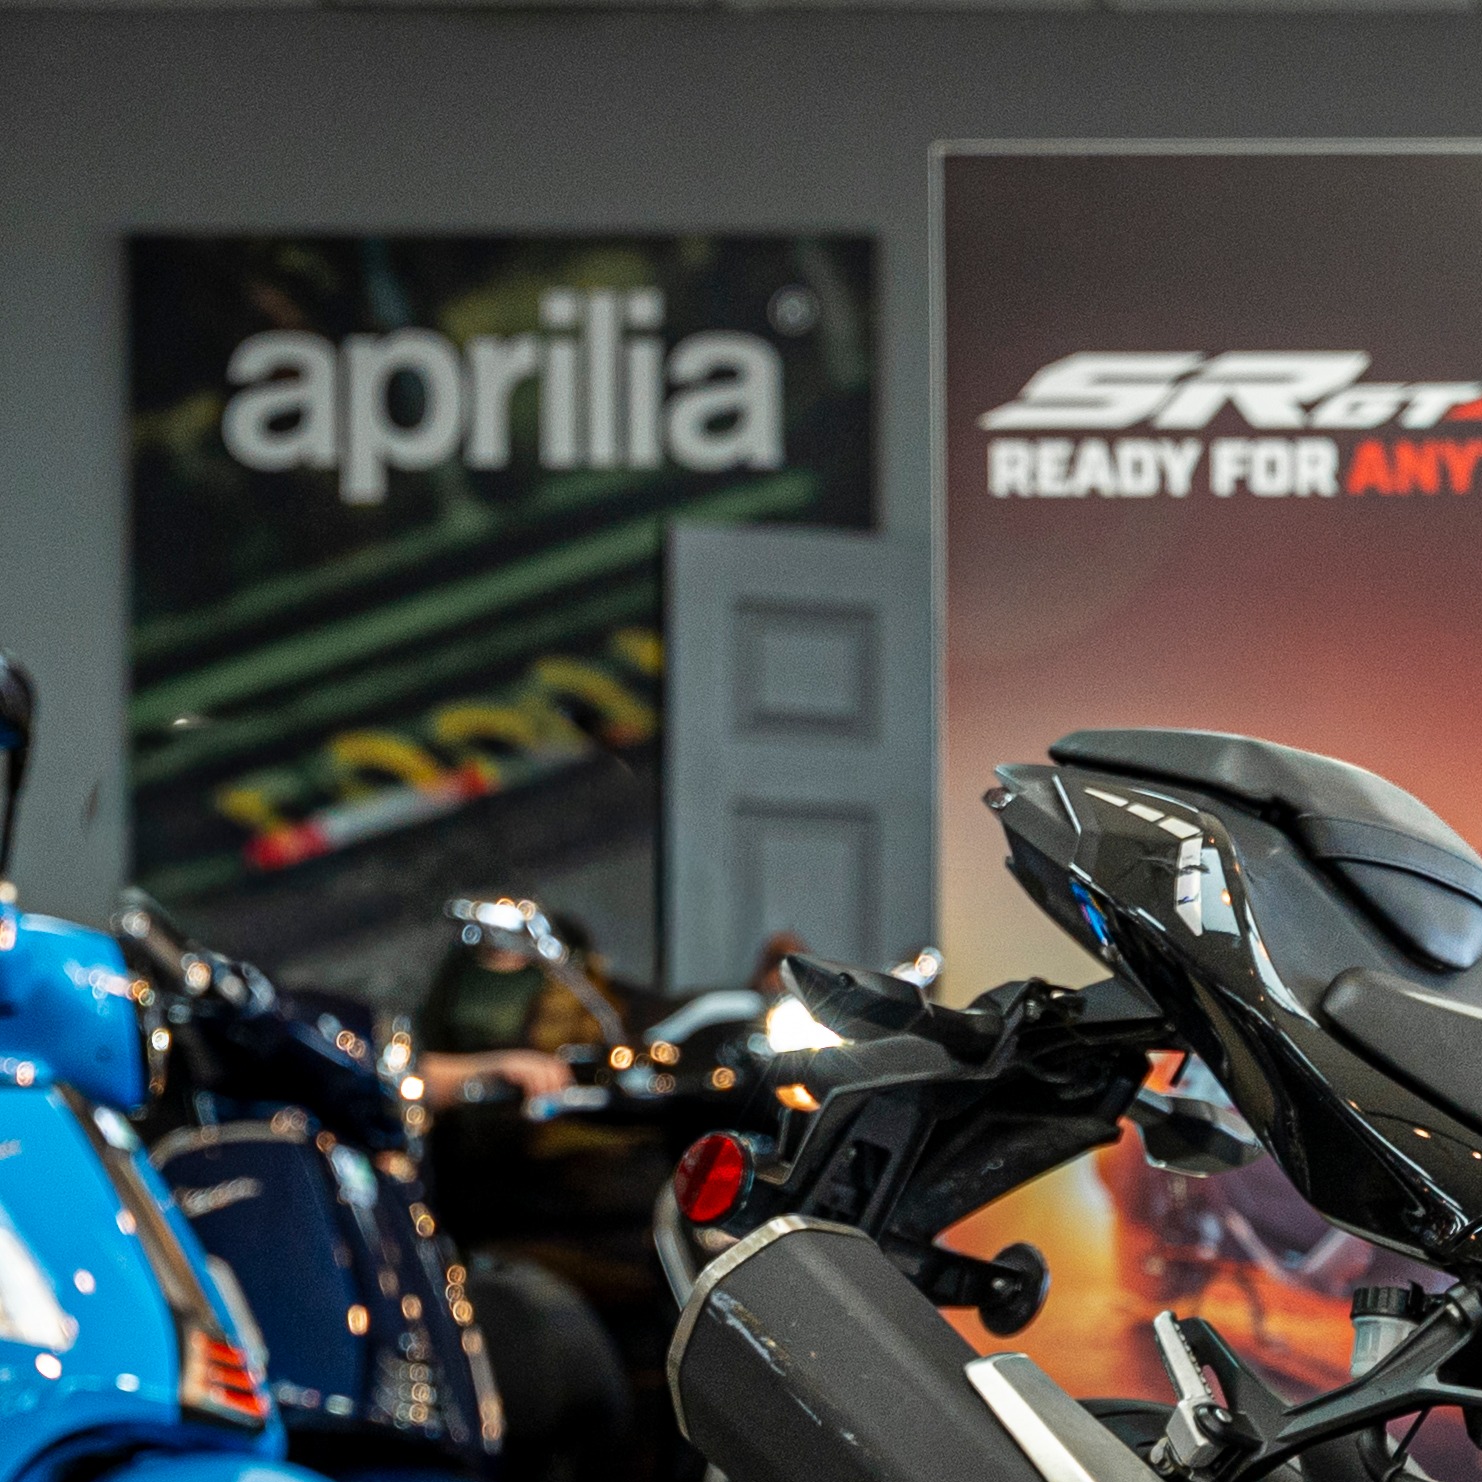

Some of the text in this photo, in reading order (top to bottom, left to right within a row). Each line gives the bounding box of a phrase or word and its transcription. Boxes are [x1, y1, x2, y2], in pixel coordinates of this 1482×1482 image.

[221, 286, 785, 505] aprilia
[986, 436, 1202, 499] READY
[1211, 436, 1339, 499] FOR
